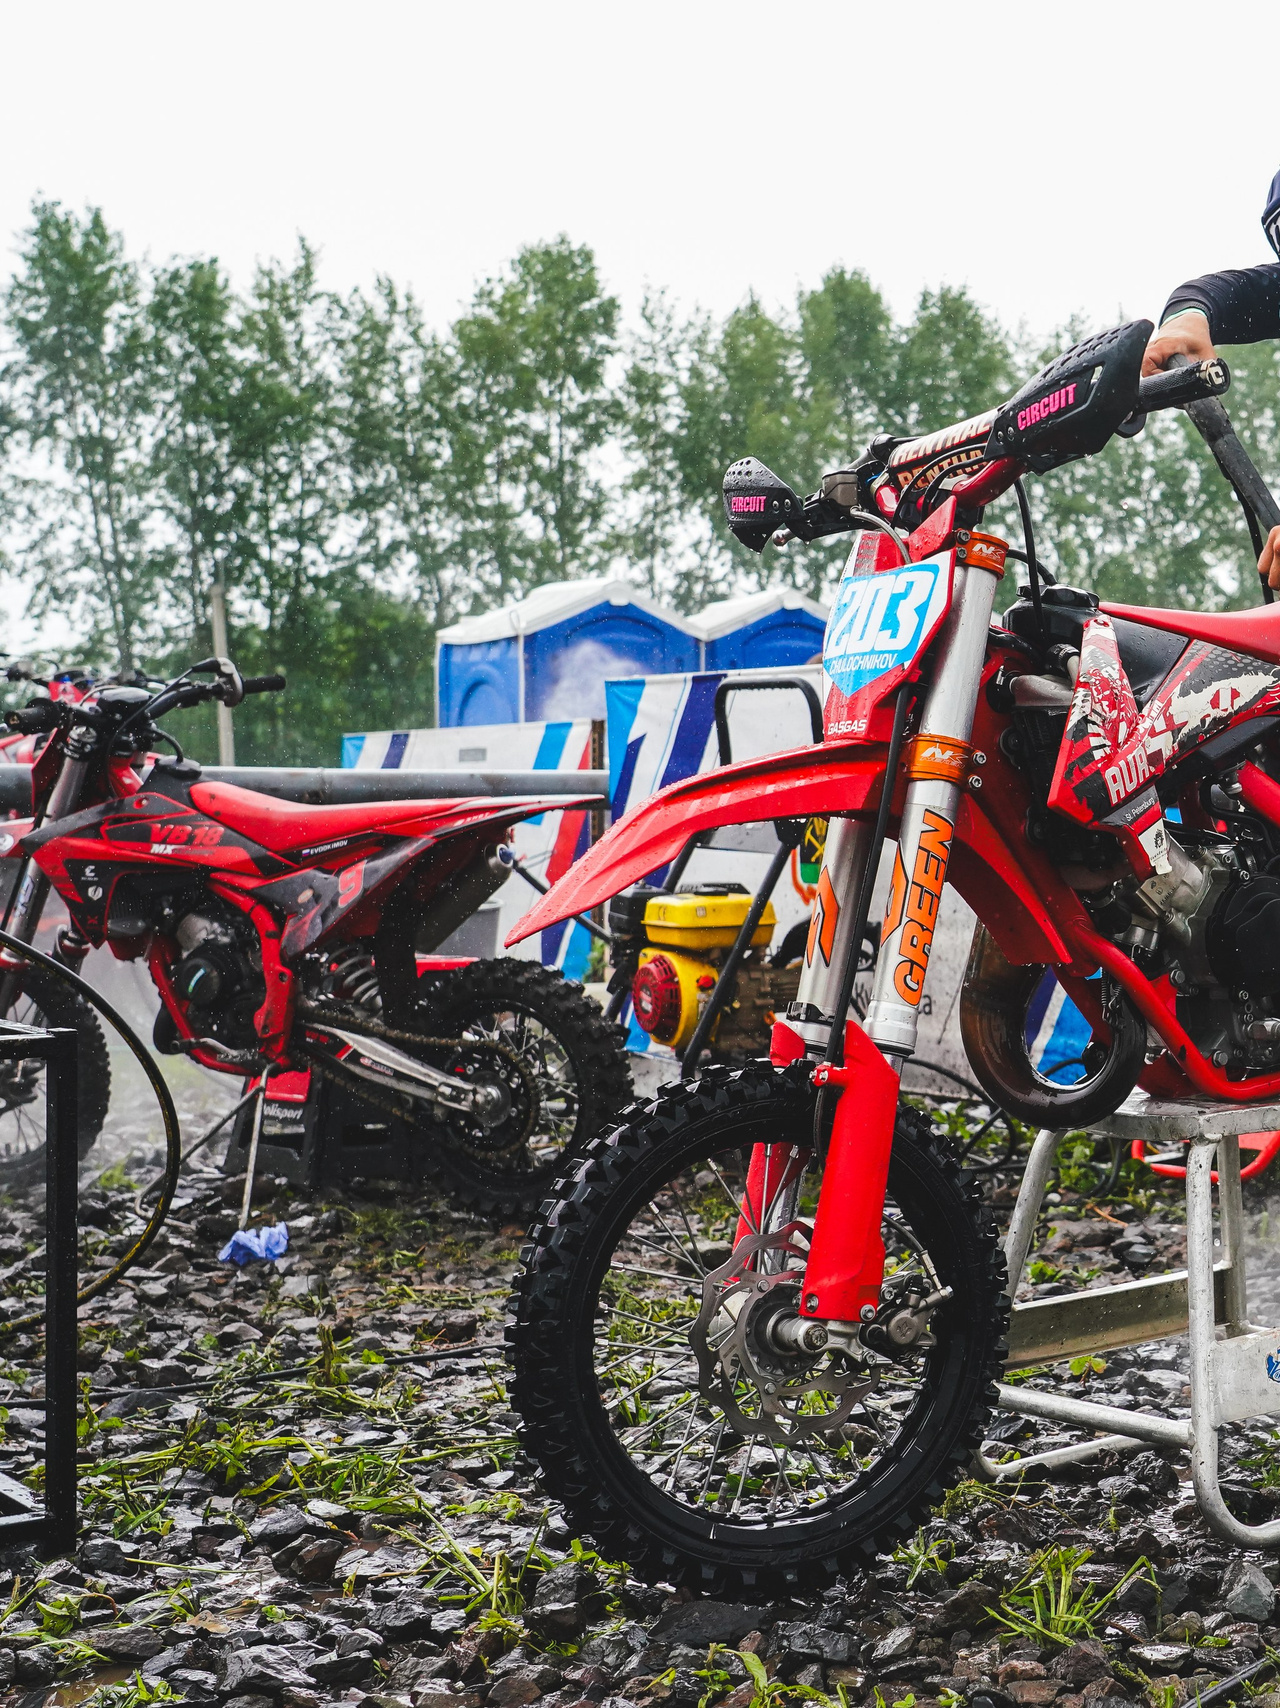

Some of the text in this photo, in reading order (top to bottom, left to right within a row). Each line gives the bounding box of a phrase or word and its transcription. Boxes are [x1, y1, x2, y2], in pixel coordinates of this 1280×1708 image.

[1017, 383, 1077, 431] CIRCUIT
[897, 449, 988, 489] RENTHA
[731, 495, 767, 513] CIRCUIT
[825, 571, 935, 660] 203
[827, 719, 868, 735] GASGAS
[1131, 797, 1155, 817] Petersburg
[310, 840, 348, 855] EVDOKIMOV
[893, 808, 954, 1006] GREEN
[263, 1103, 304, 1120] olisport
